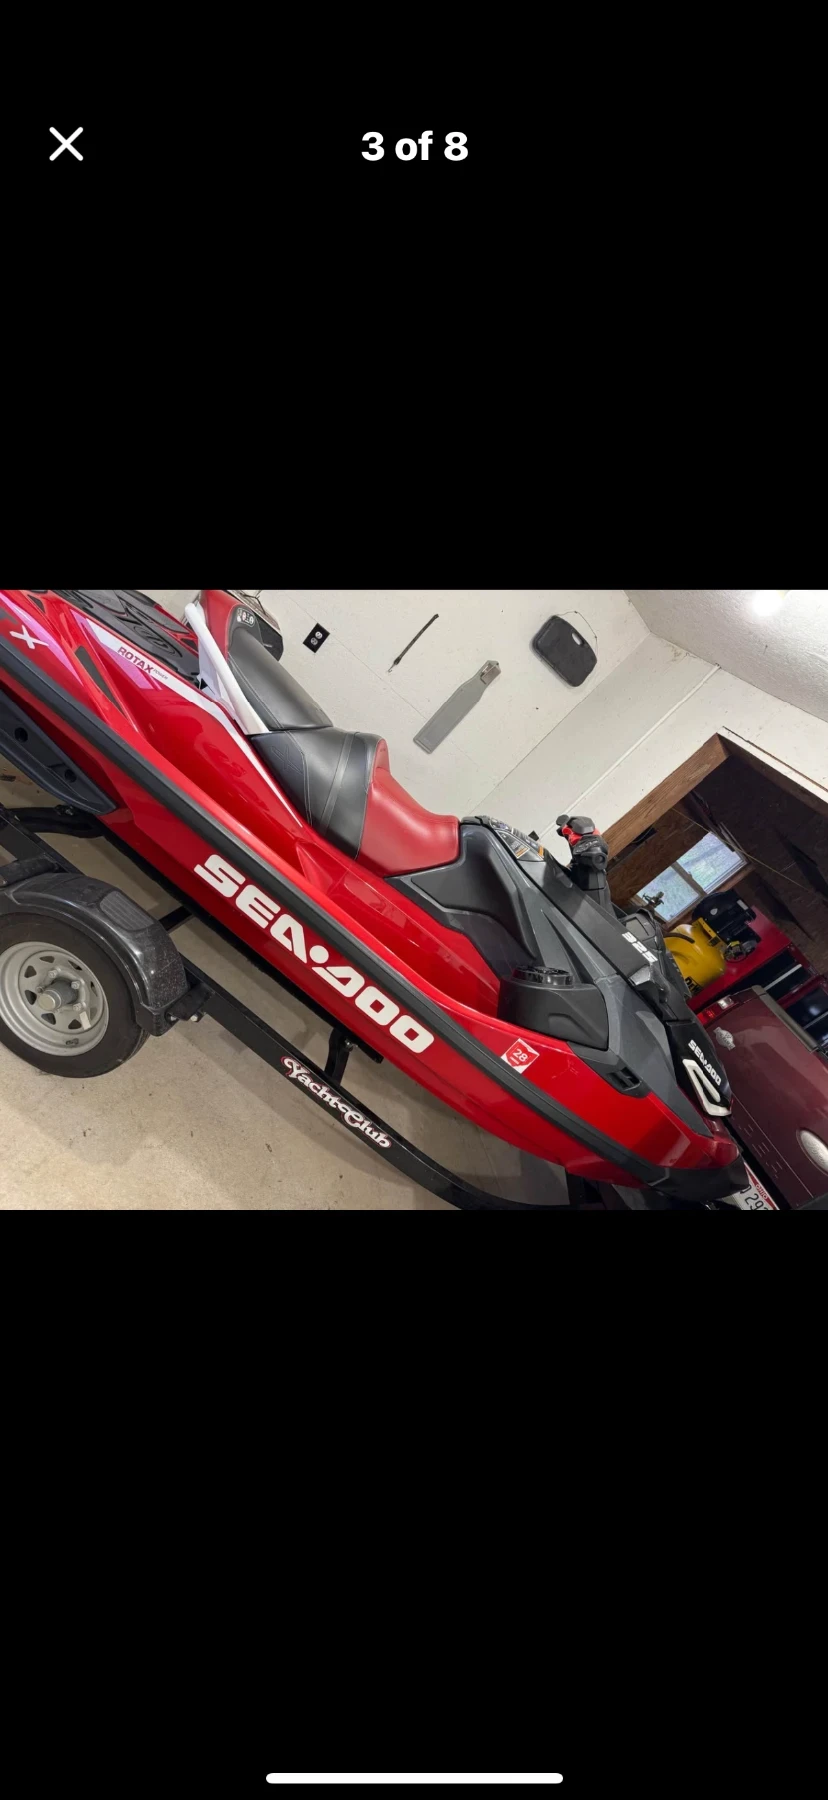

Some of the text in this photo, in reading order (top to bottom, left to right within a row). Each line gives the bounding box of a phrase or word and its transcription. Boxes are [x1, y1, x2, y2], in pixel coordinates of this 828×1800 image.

[117, 646, 154, 674] ROTAX
[621, 931, 659, 963] 325
[512, 1048, 529, 1062] 28
[755, 1184, 769, 1200] OHIO
